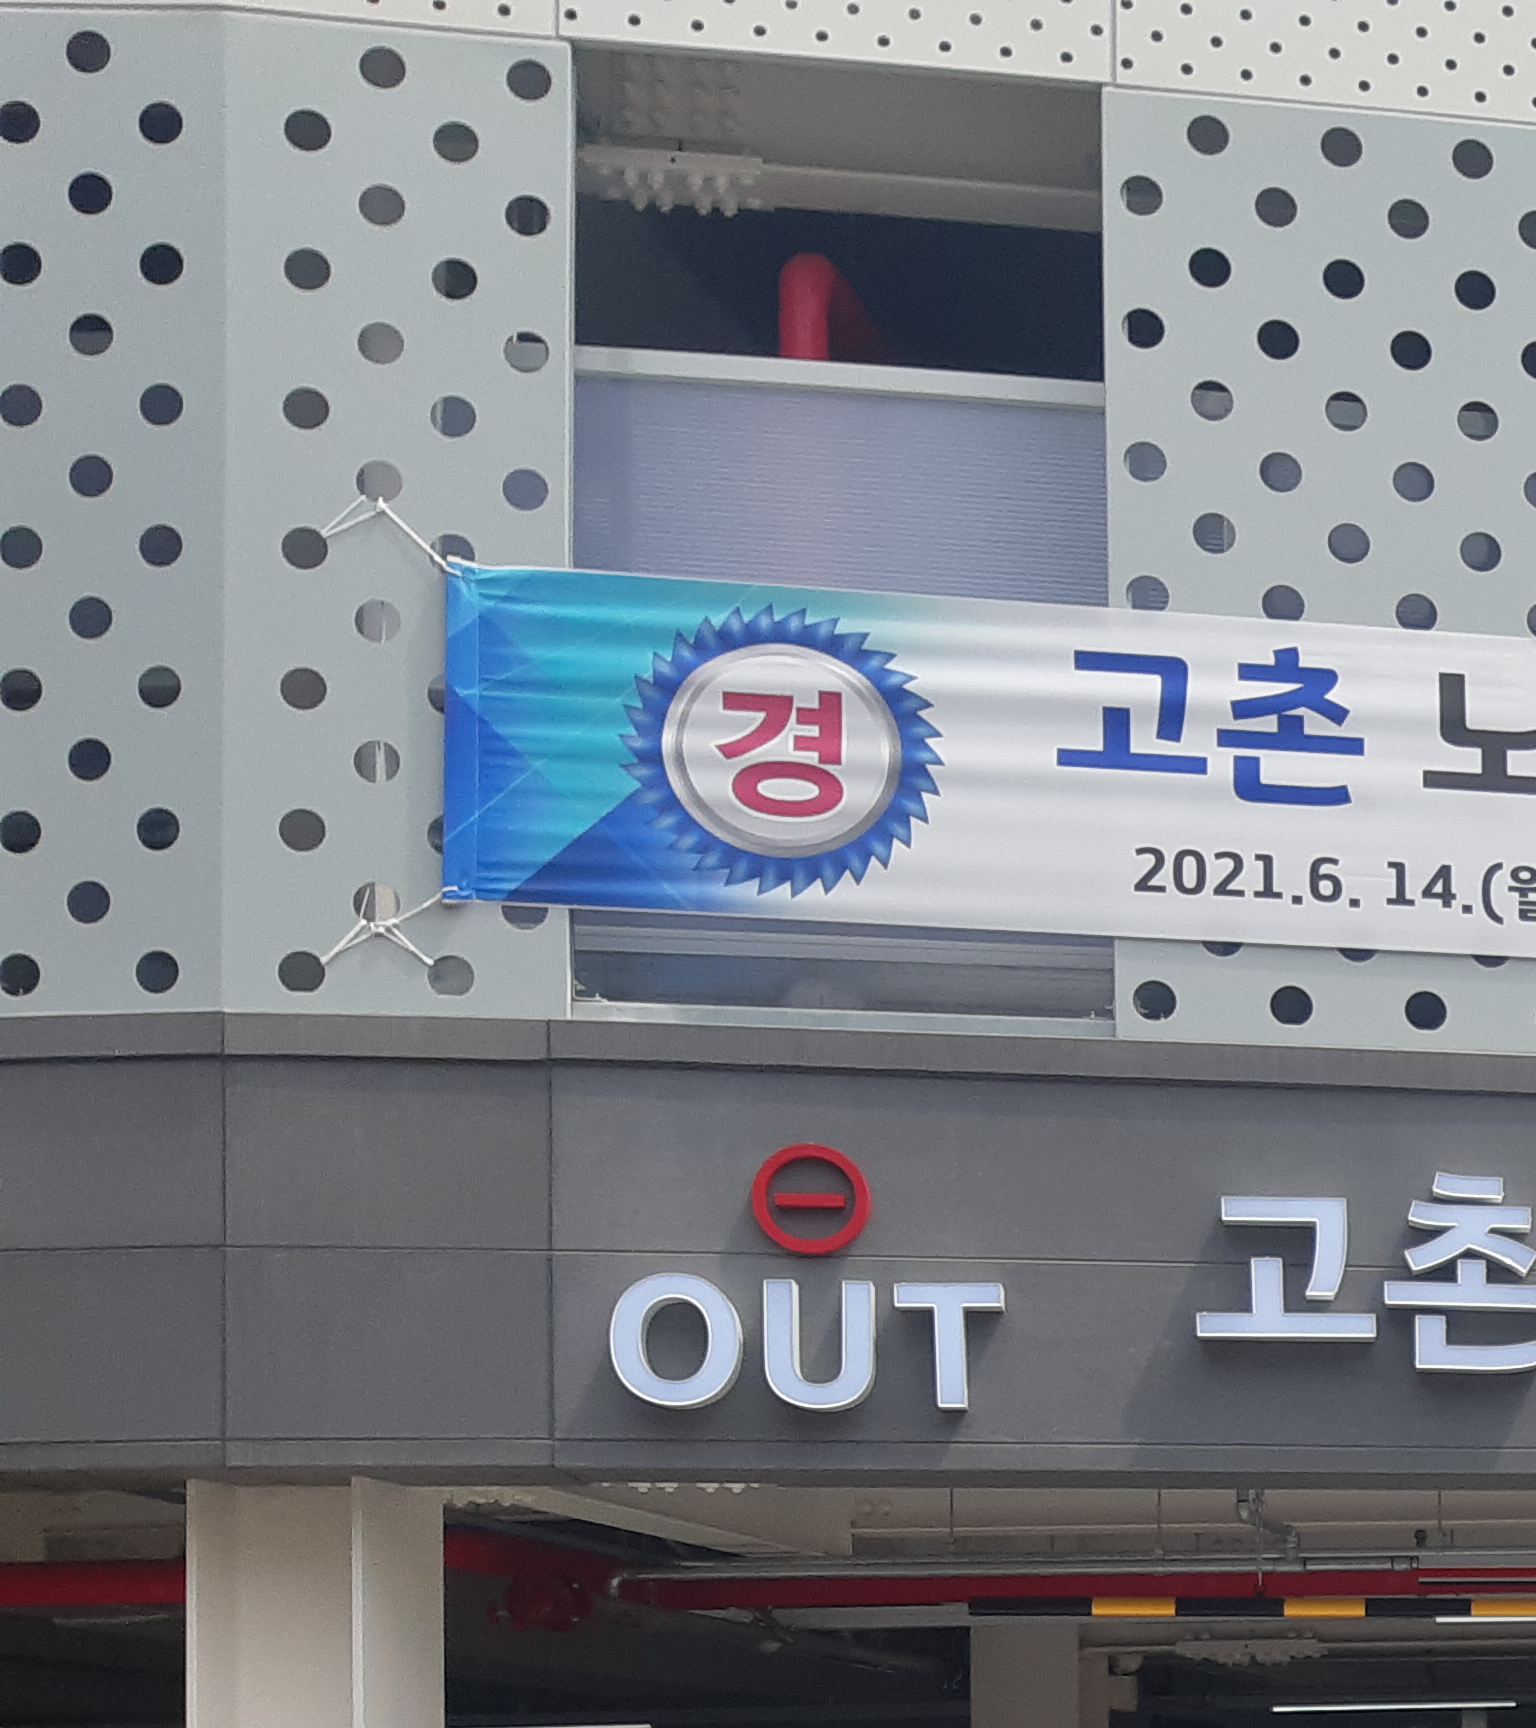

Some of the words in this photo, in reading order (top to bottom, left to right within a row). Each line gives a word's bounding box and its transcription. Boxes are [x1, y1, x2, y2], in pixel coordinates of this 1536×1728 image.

[717, 691, 845, 818] 경
[1056, 646, 1366, 808] 고촌
[609, 1272, 1006, 1410] OUT
